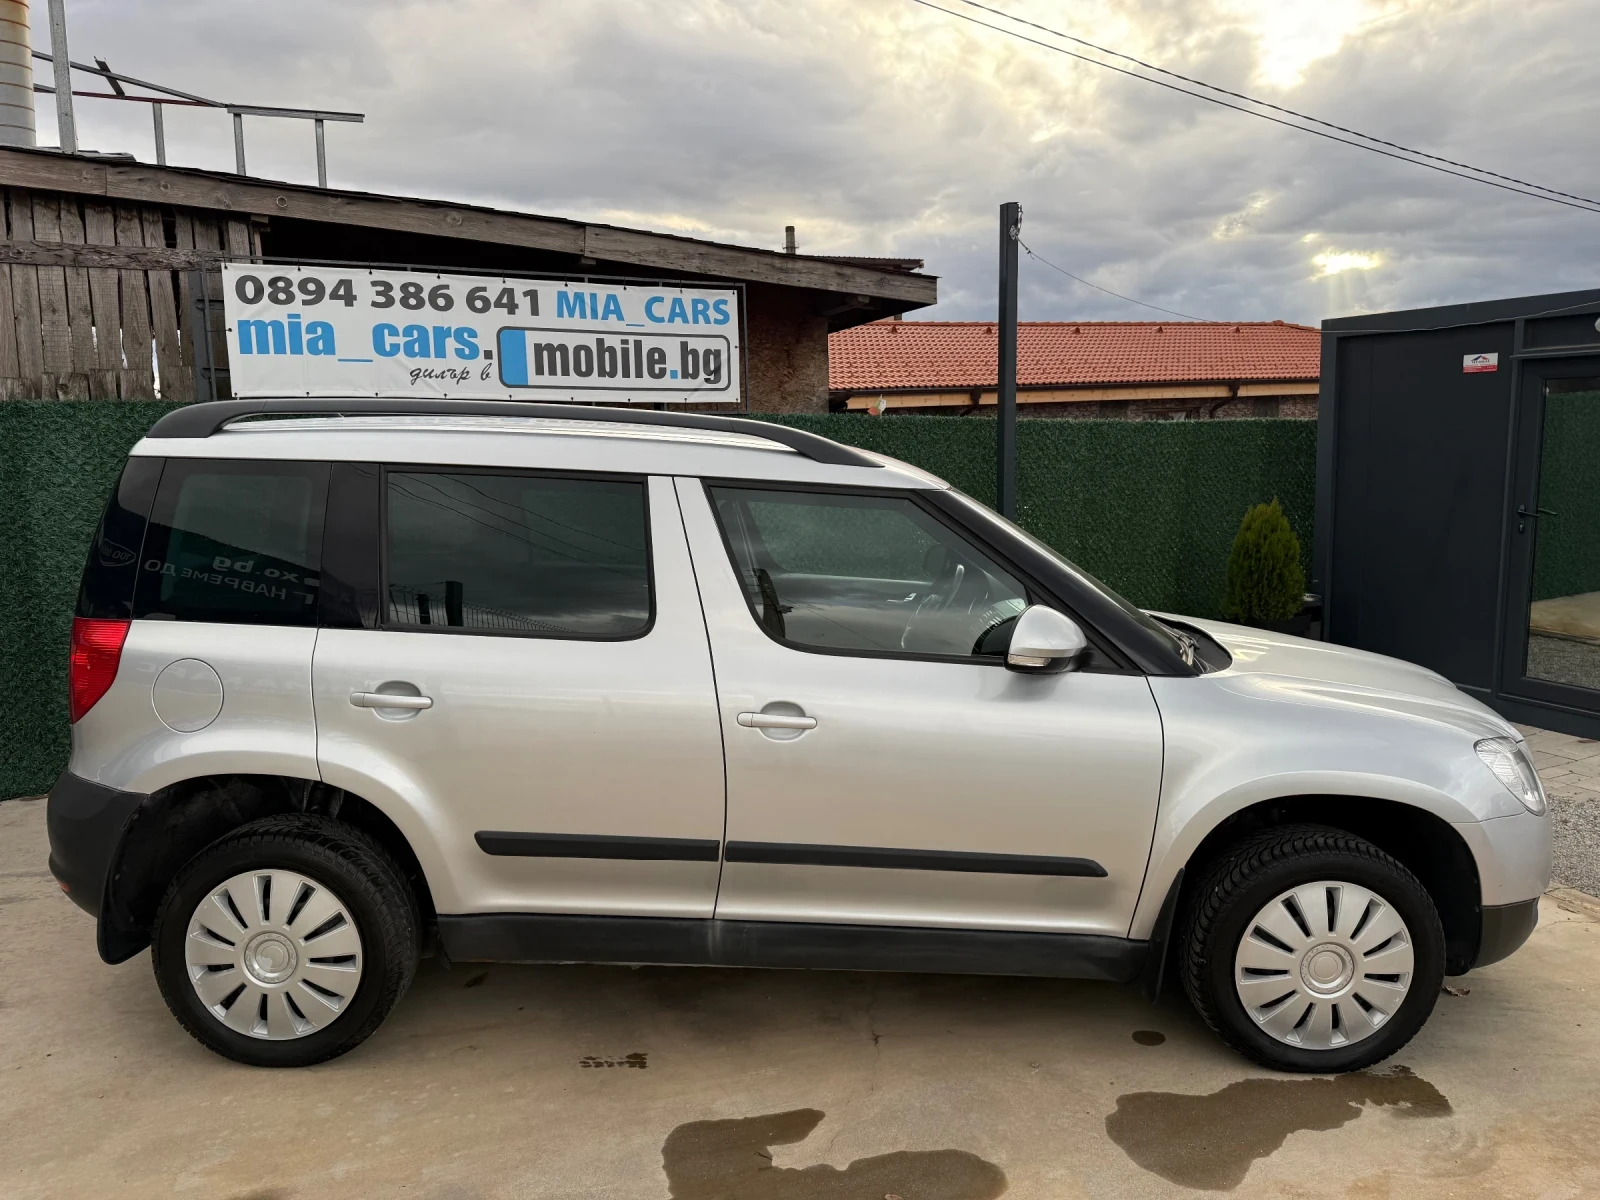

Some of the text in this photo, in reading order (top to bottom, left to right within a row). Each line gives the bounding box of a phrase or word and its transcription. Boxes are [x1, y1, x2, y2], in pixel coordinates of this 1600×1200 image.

[235, 275, 731, 328] 0894 386 641 MIA_CARS
[410, 363, 493, 386] дилър в
[533, 337, 722, 385] mobile.bg
